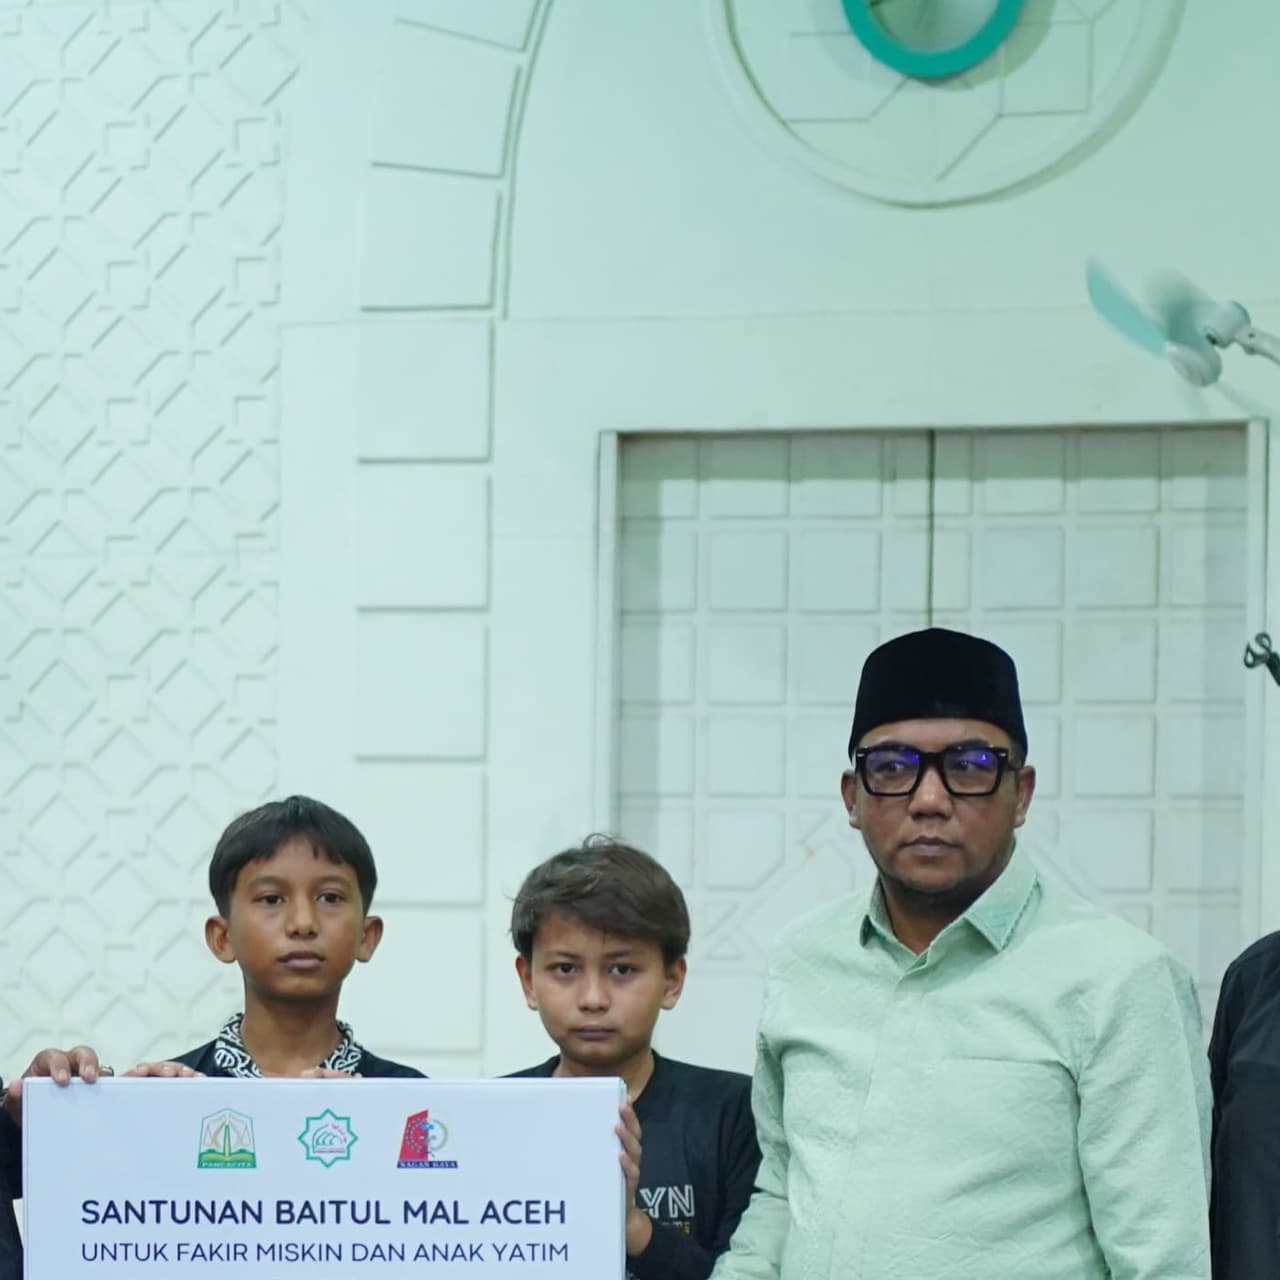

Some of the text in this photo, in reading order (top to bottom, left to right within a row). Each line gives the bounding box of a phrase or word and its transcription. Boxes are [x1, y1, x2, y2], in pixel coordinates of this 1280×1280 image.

[81, 1199, 566, 1225] SANTUNAN BAITUL MAL ACEH
[639, 1184, 695, 1219] YN
[81, 1242, 568, 1262] UNTUK FAKIR MISKIN DAN ANAK YATIM
